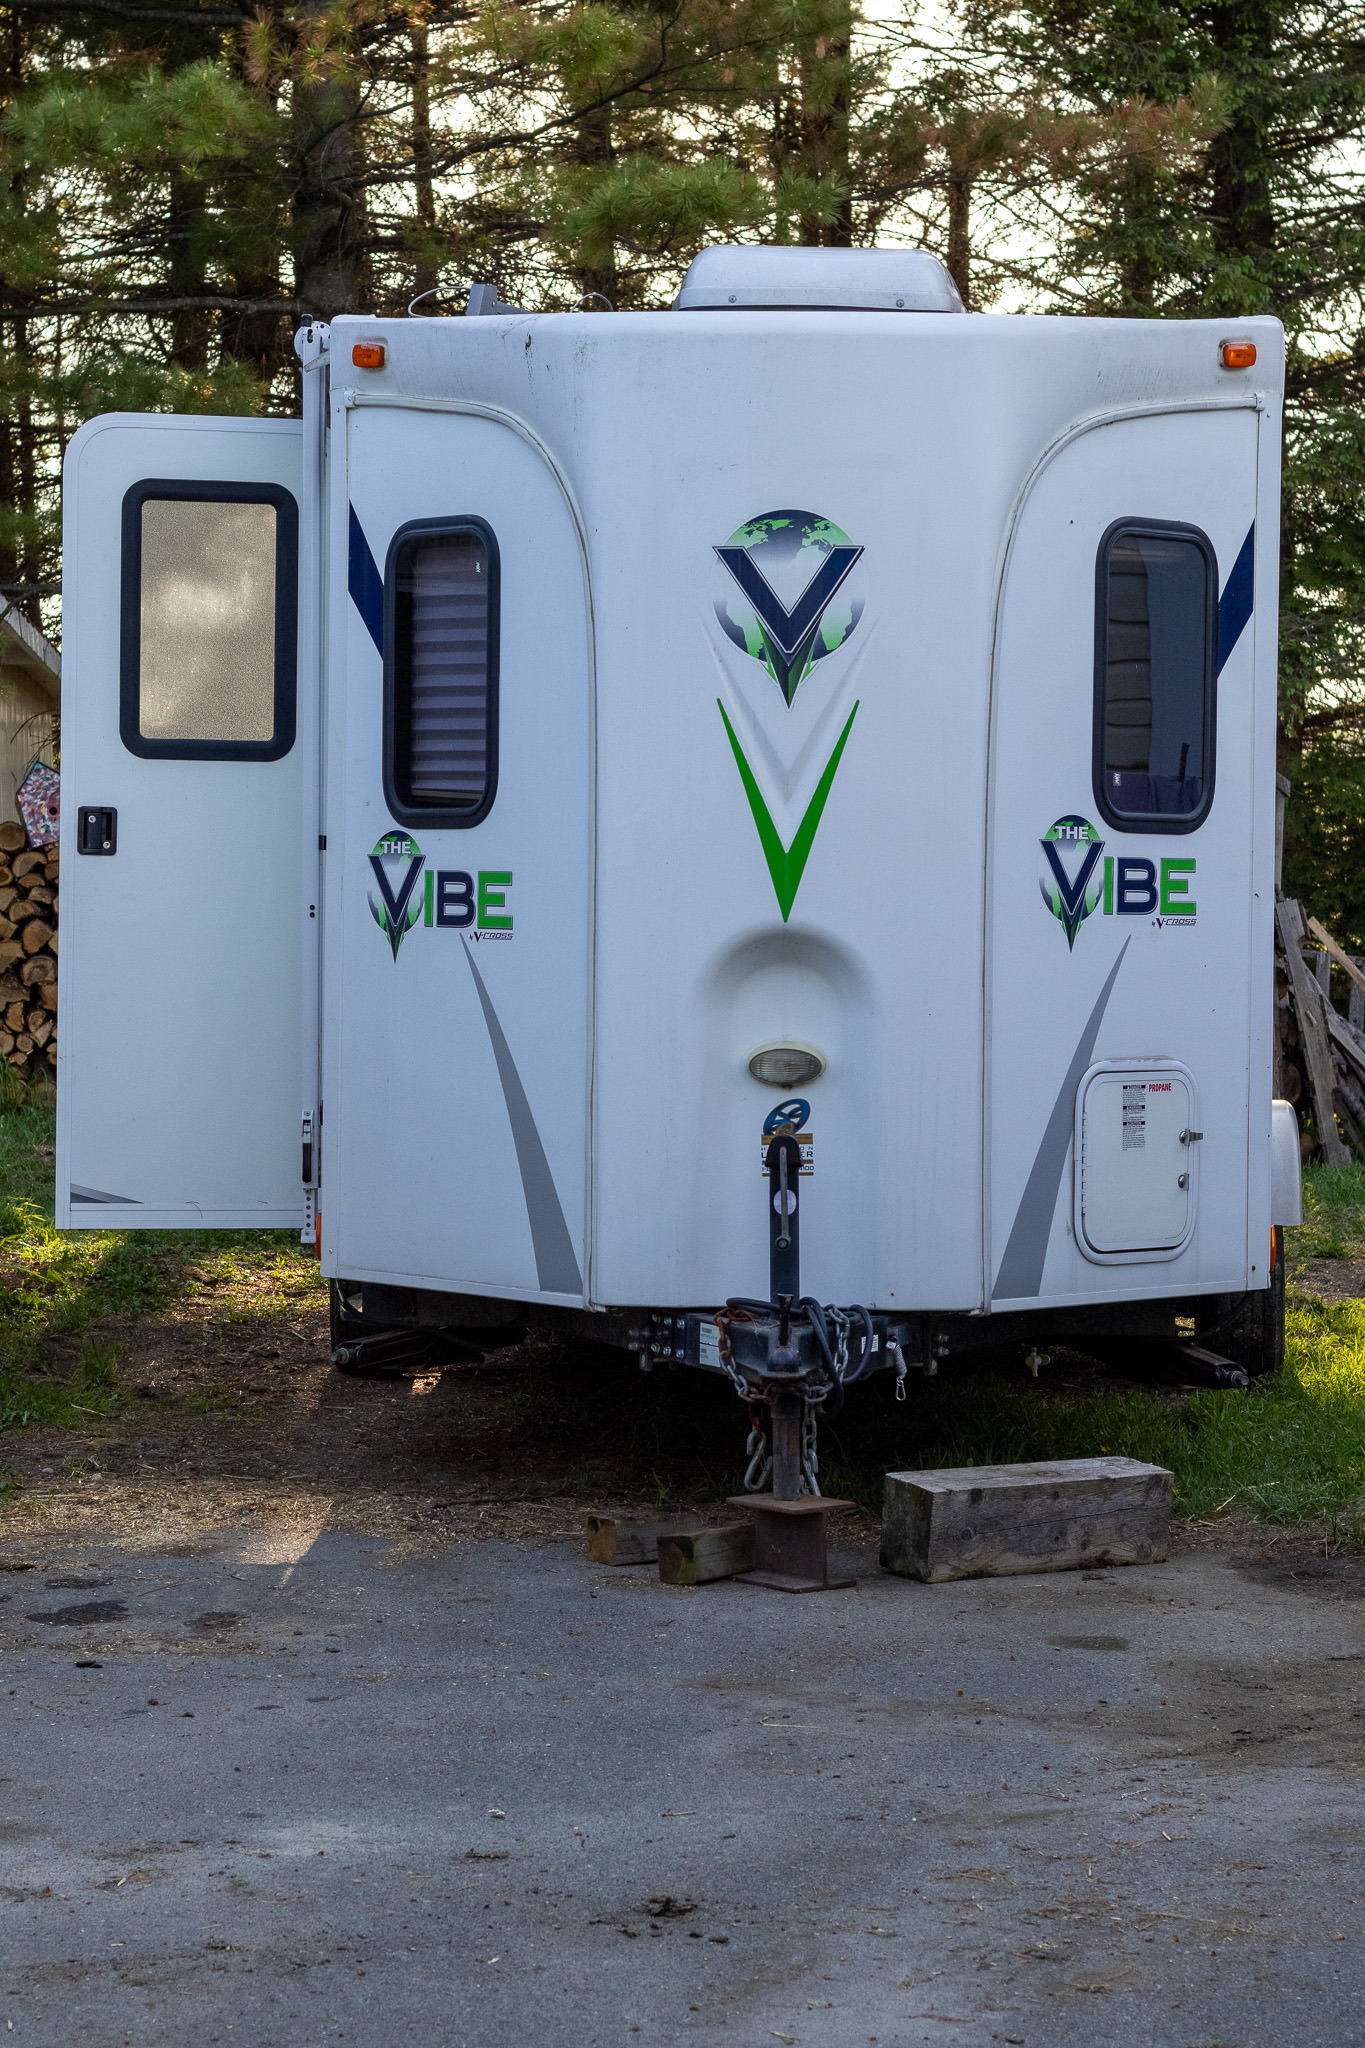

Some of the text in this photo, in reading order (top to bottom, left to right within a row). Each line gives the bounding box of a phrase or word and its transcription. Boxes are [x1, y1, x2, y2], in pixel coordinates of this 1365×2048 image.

[1055, 825, 1090, 840] THE
[380, 841, 412, 854] THE
[1039, 839, 1197, 916] VIBE
[367, 854, 514, 930] VIBE
[1156, 917, 1198, 929] V-CROSS
[473, 931, 514, 943] V-CROSS
[1148, 1083, 1172, 1092] PROPANE
